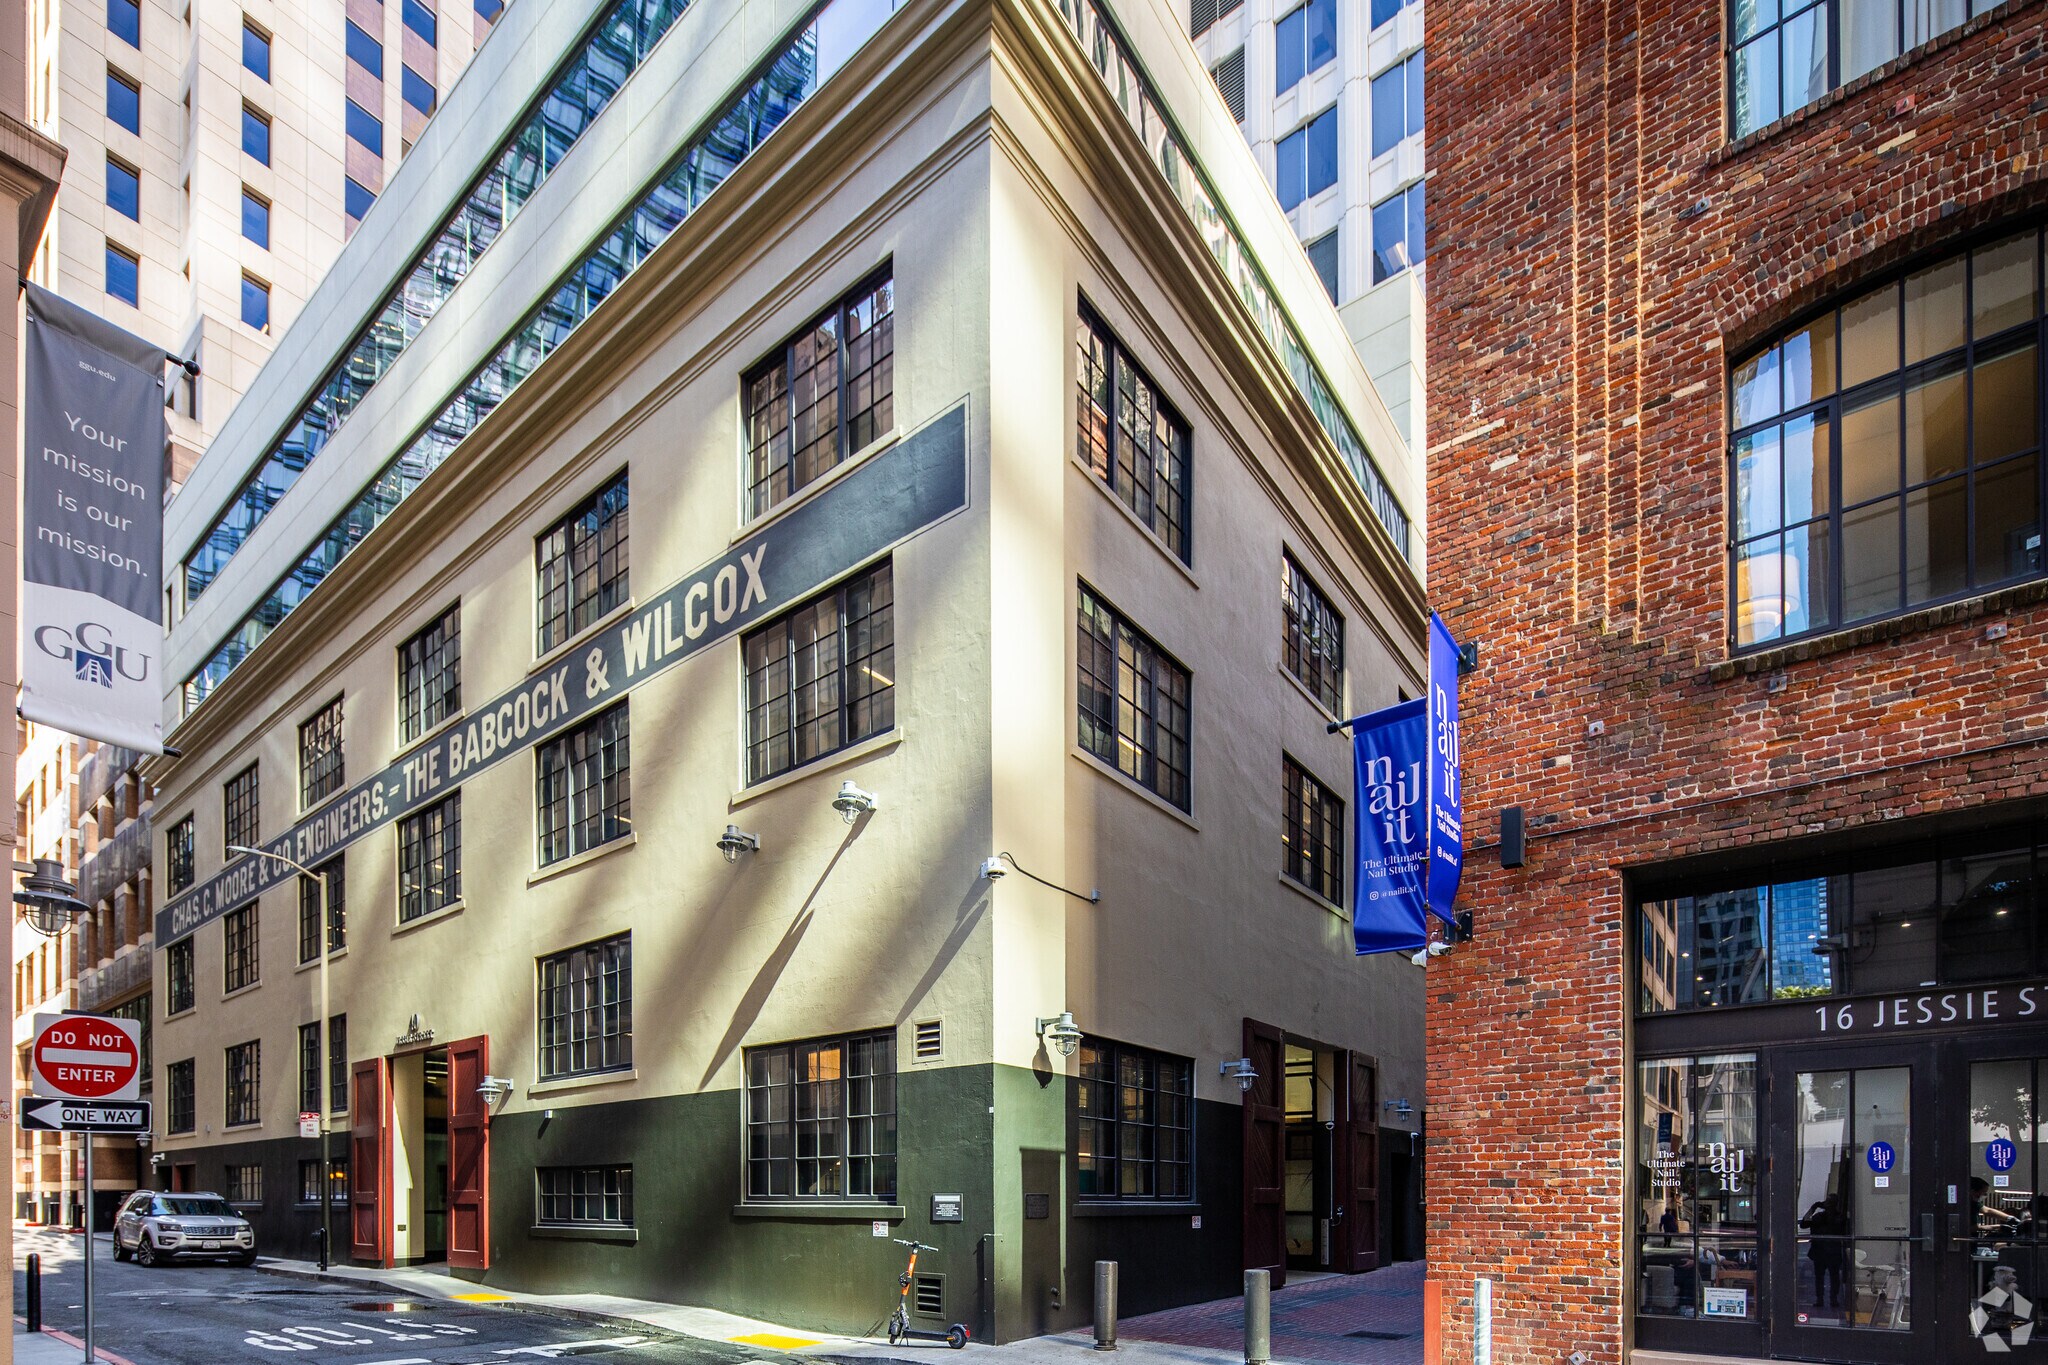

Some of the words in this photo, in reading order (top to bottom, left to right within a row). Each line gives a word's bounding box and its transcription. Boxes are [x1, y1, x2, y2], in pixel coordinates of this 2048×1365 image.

[79, 360, 116, 382] ggu.edu
[64, 411, 128, 452] Your
[43, 447, 146, 500] mission
[57, 489, 78, 513] is
[86, 506, 132, 532] our
[38, 523, 148, 577] mission.
[34, 622, 151, 682] GGU
[172, 896, 202, 935] CHAS.
[203, 888, 214, 917] C.
[215, 860, 256, 911] MOORE
[258, 855, 270, 886] &
[403, 745, 442, 803] THE
[449, 665, 569, 779] BABCOCK
[585, 647, 612, 700] &
[621, 542, 767, 678] WILCOX
[1444, 761, 1458, 808] it
[1383, 808, 1416, 844] it
[1363, 859, 1382, 870] The
[1384, 851, 1423, 866] Ultimate
[1368, 867, 1387, 879] Nail
[1389, 863, 1420, 875] Studio
[1815, 1004, 1854, 1031] 16
[1873, 990, 1999, 1027] JESSIE
[2018, 986, 2048, 1015] S
[51, 1031, 76, 1045] DO
[89, 1034, 124, 1048] NOT
[57, 1067, 116, 1083] ENTER
[62, 1109, 97, 1122] ONE
[103, 1110, 137, 1122] WAY
[1657, 1150, 1675, 1158] The
[1998, 1158, 2009, 1168] it
[1646, 1160, 1686, 1168] Ultimate
[1657, 1168, 1675, 1177] Nail
[1878, 1159, 1889, 1169] it
[1651, 1178, 1681, 1187] Studio
[1719, 1173, 1742, 1192] it
